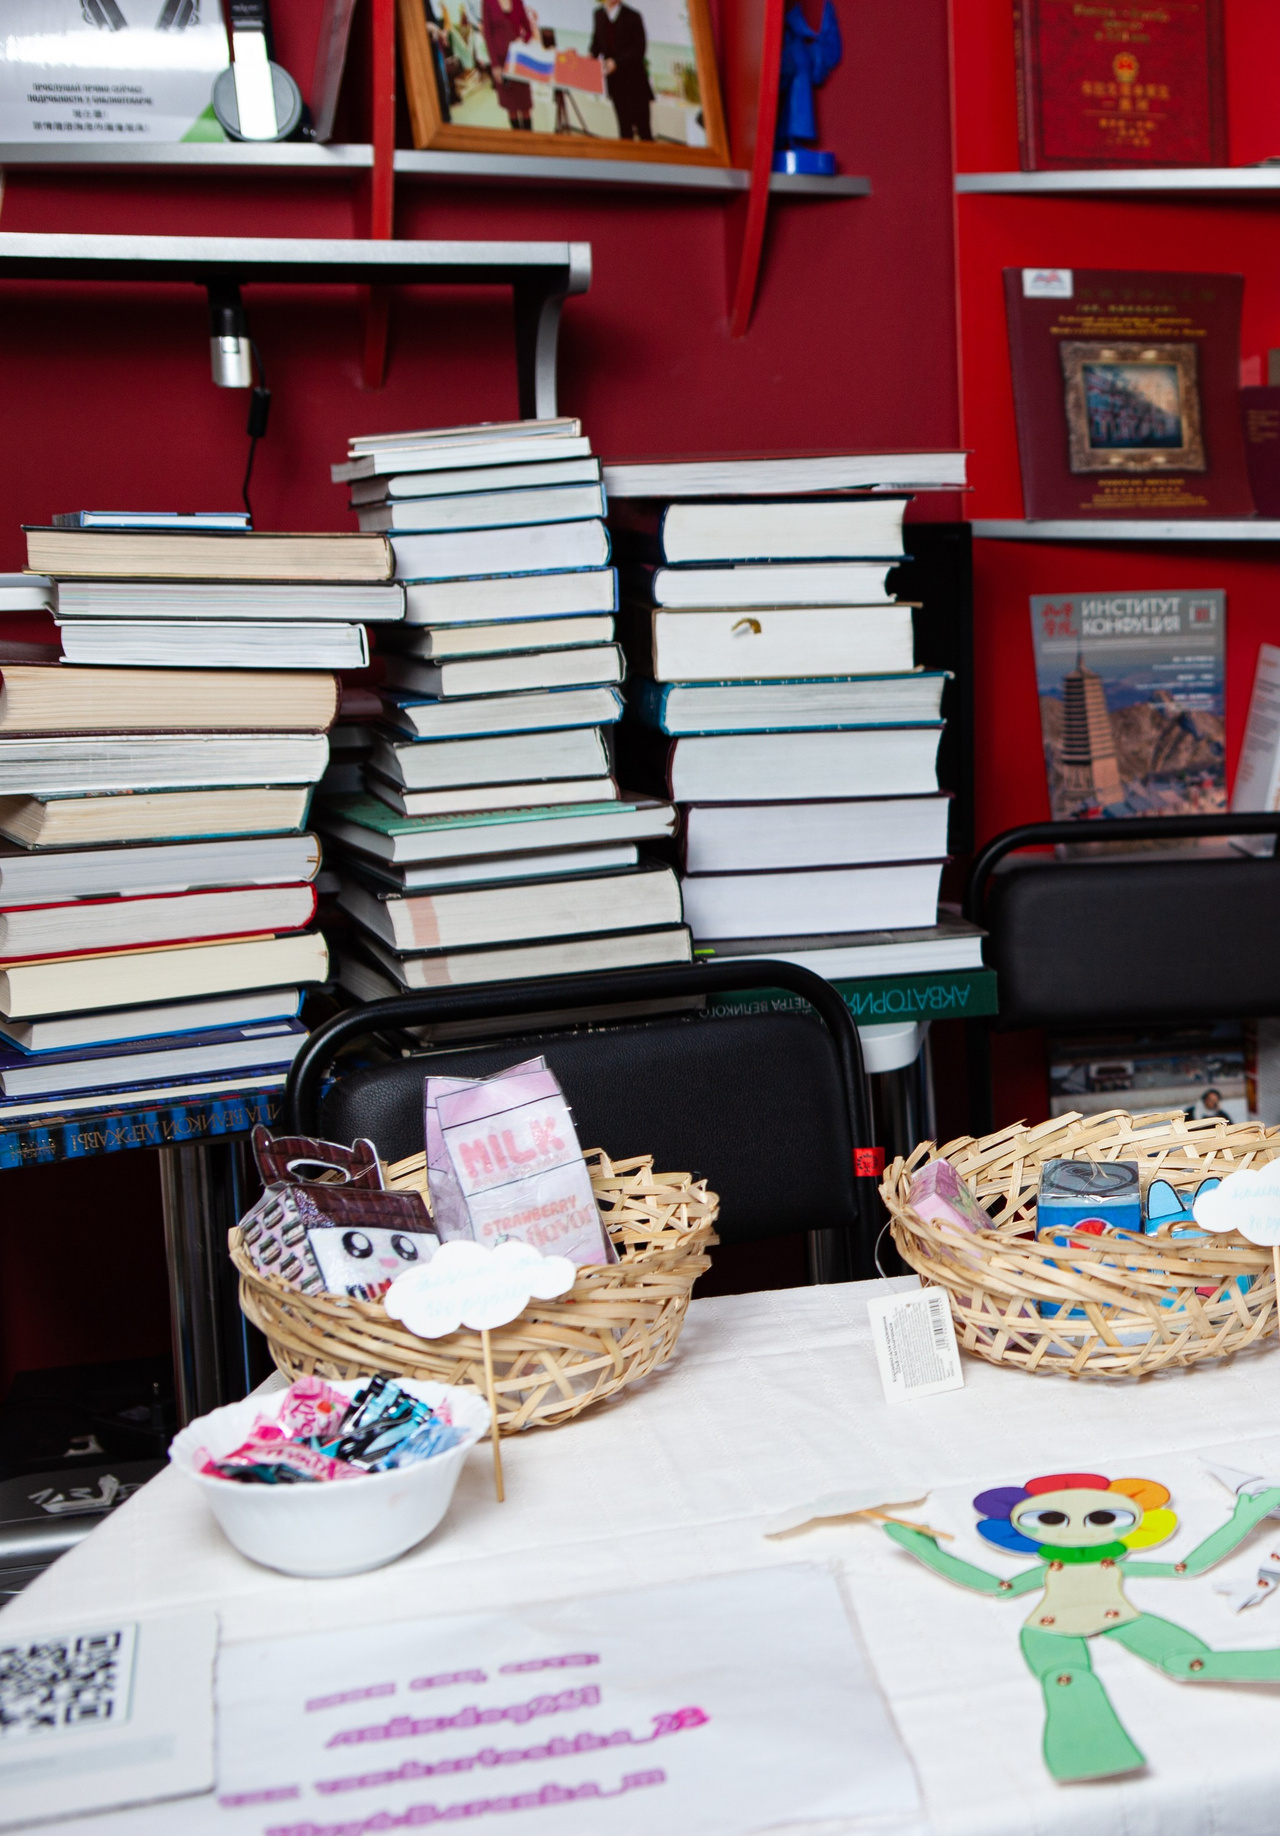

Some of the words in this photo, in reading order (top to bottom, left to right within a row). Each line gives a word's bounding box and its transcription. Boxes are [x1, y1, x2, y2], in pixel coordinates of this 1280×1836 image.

[1081, 597, 1182, 616] ИНСТИТУТ
[1081, 615, 1182, 636] КОНФУЦИЯ
[70, 1124, 155, 1151] ДЕРЖАВЫ
[162, 1110, 243, 1140] ВЕЛИКОЙ
[459, 1116, 565, 1179] MILK
[482, 1195, 577, 1237] STRAWBERRY
[526, 1204, 595, 1247] flavor
